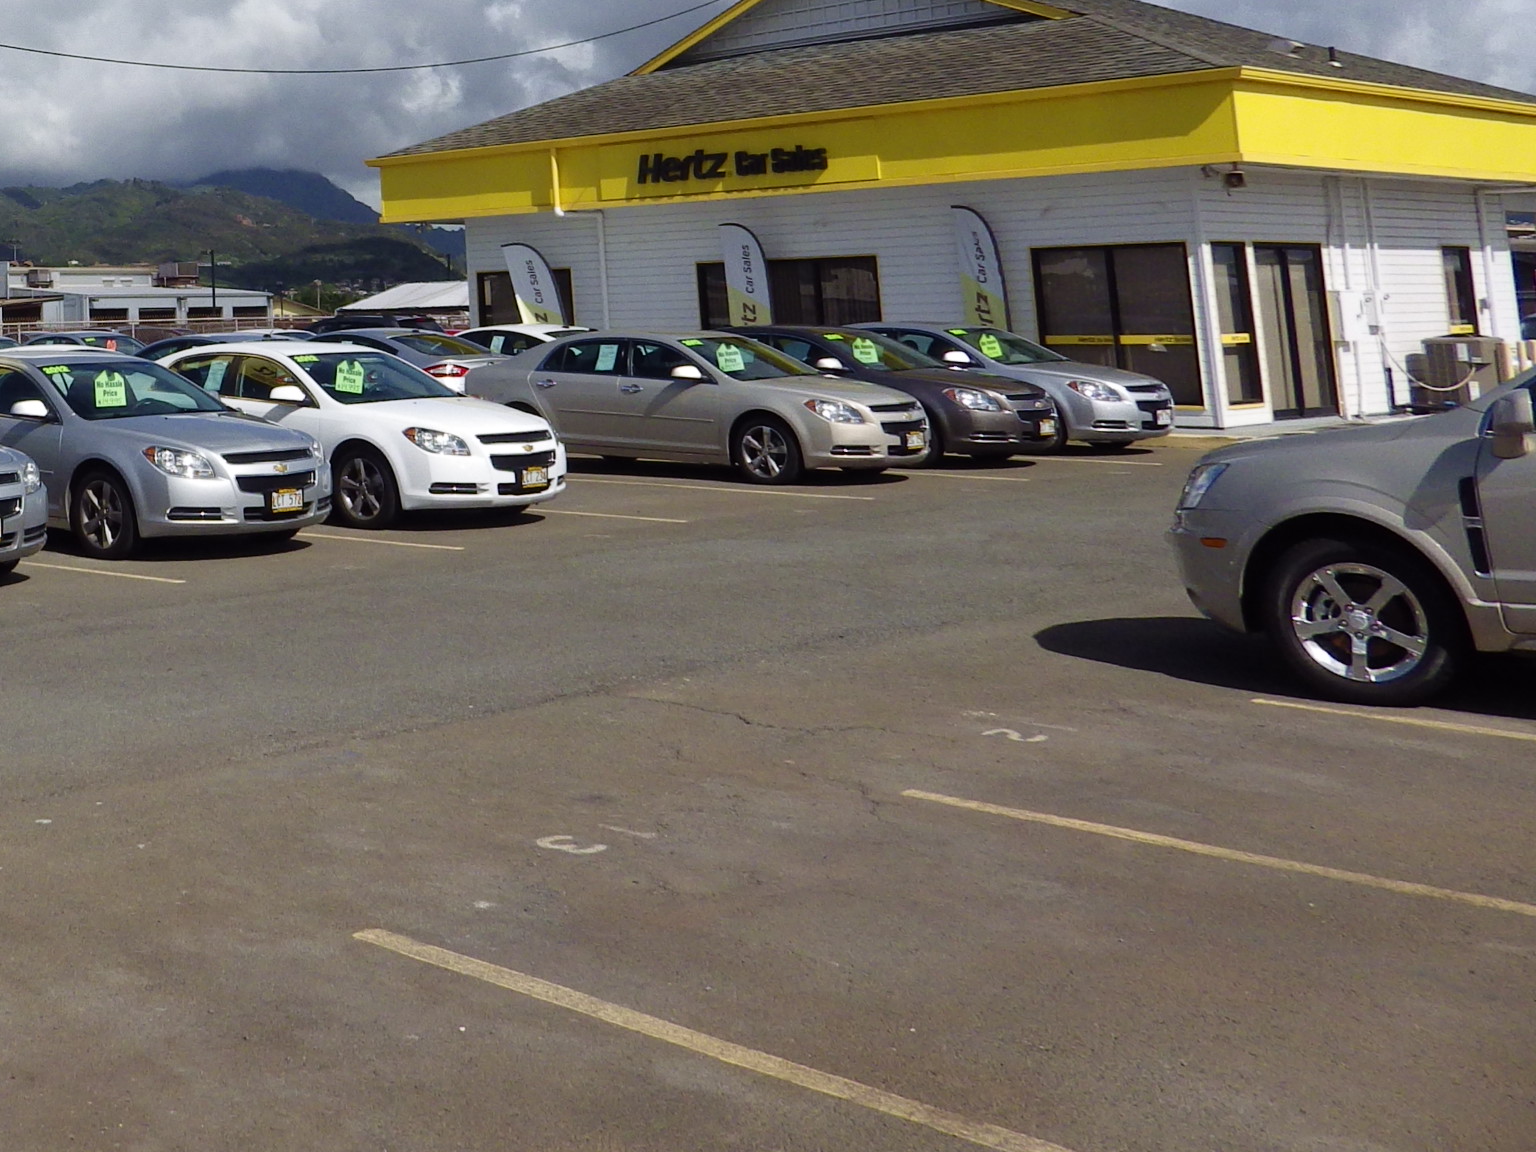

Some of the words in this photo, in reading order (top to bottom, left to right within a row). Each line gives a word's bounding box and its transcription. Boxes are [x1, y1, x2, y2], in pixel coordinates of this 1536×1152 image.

[637, 149, 728, 184] Hertz
[734, 151, 769, 176] Car
[770, 145, 828, 173] Sales
[741, 244, 752, 274] Sales
[525, 259, 539, 286] Sales
[977, 263, 988, 284] Car
[746, 276, 755, 294] Car
[533, 287, 544, 304] Car
[42, 365, 71, 374] 2012
[102, 389, 118, 397] Price
[105, 380, 123, 388] Hassle
